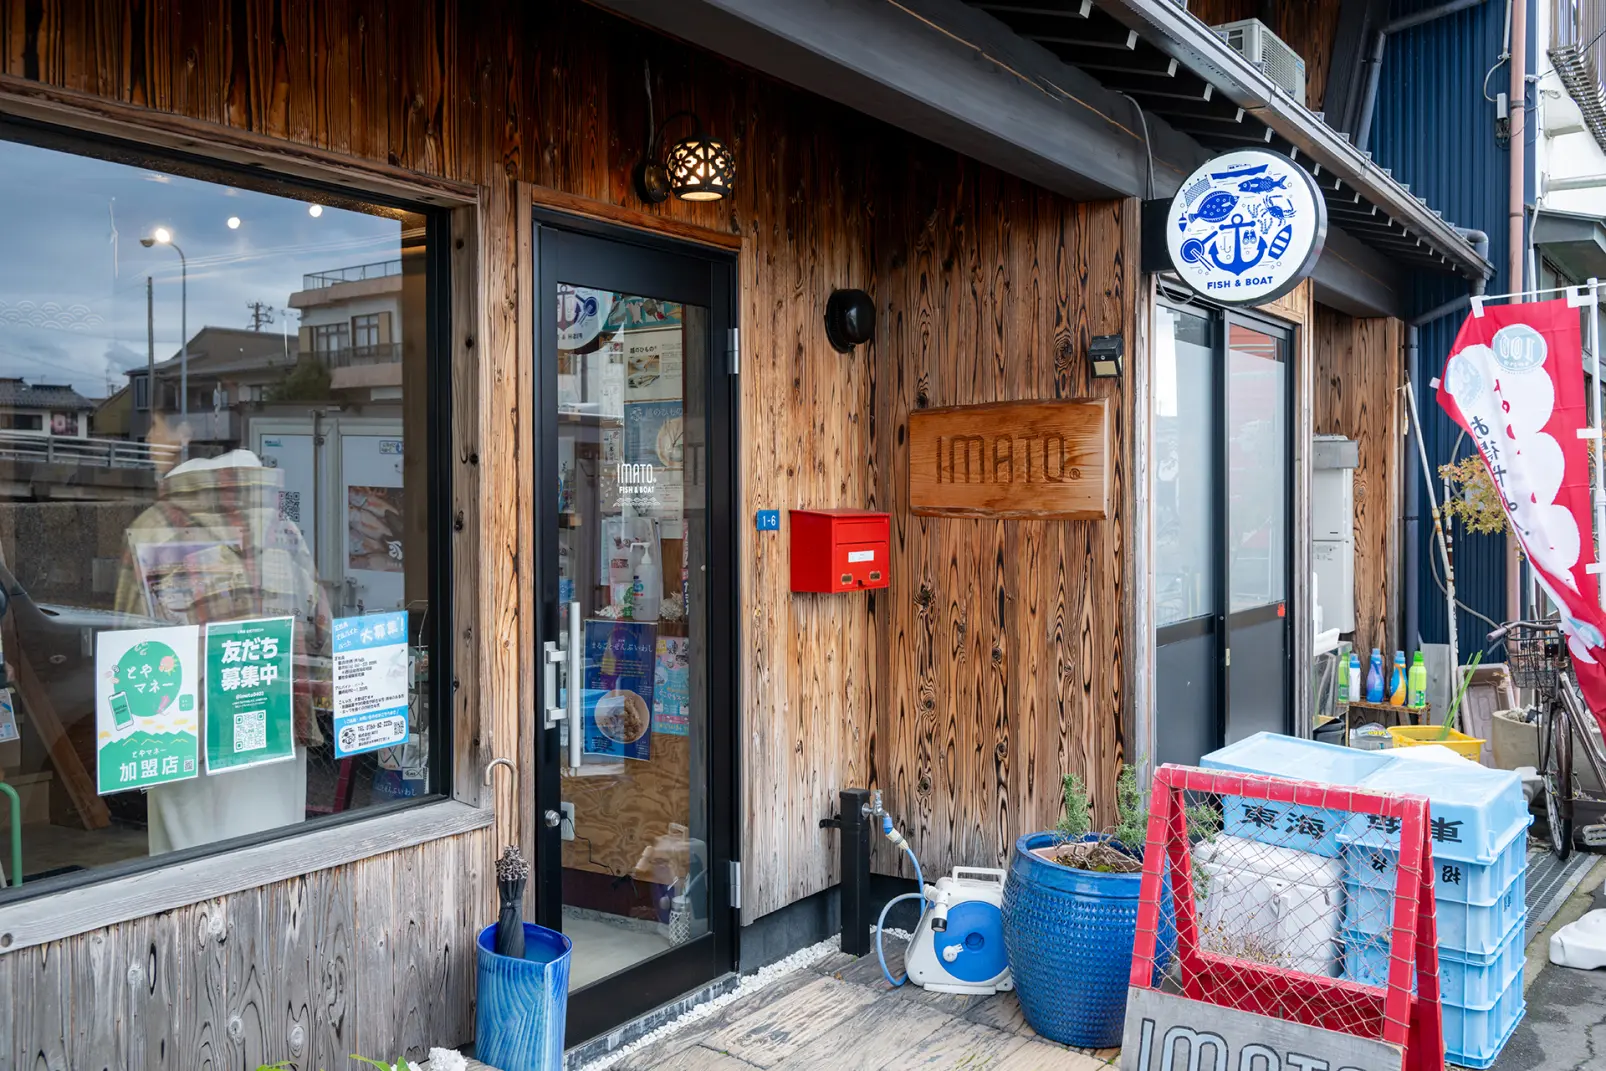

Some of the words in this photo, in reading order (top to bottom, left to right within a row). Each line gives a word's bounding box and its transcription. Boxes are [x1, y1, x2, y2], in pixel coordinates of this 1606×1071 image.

[1207, 280, 1231, 290] FISH
[1235, 279, 1242, 287] &
[1245, 276, 1274, 286] BOAT
[619, 486, 633, 494] FISH
[640, 486, 655, 494] BOAT
[762, 515, 777, 527] 1-6
[221, 637, 279, 664] 友だち
[127, 663, 153, 680] とや
[221, 663, 279, 692] 募集中
[134, 679, 174, 694] マネー
[132, 747, 167, 759] とやマネー
[119, 755, 179, 783] 加盟店
[1241, 803, 1326, 840] 東海
